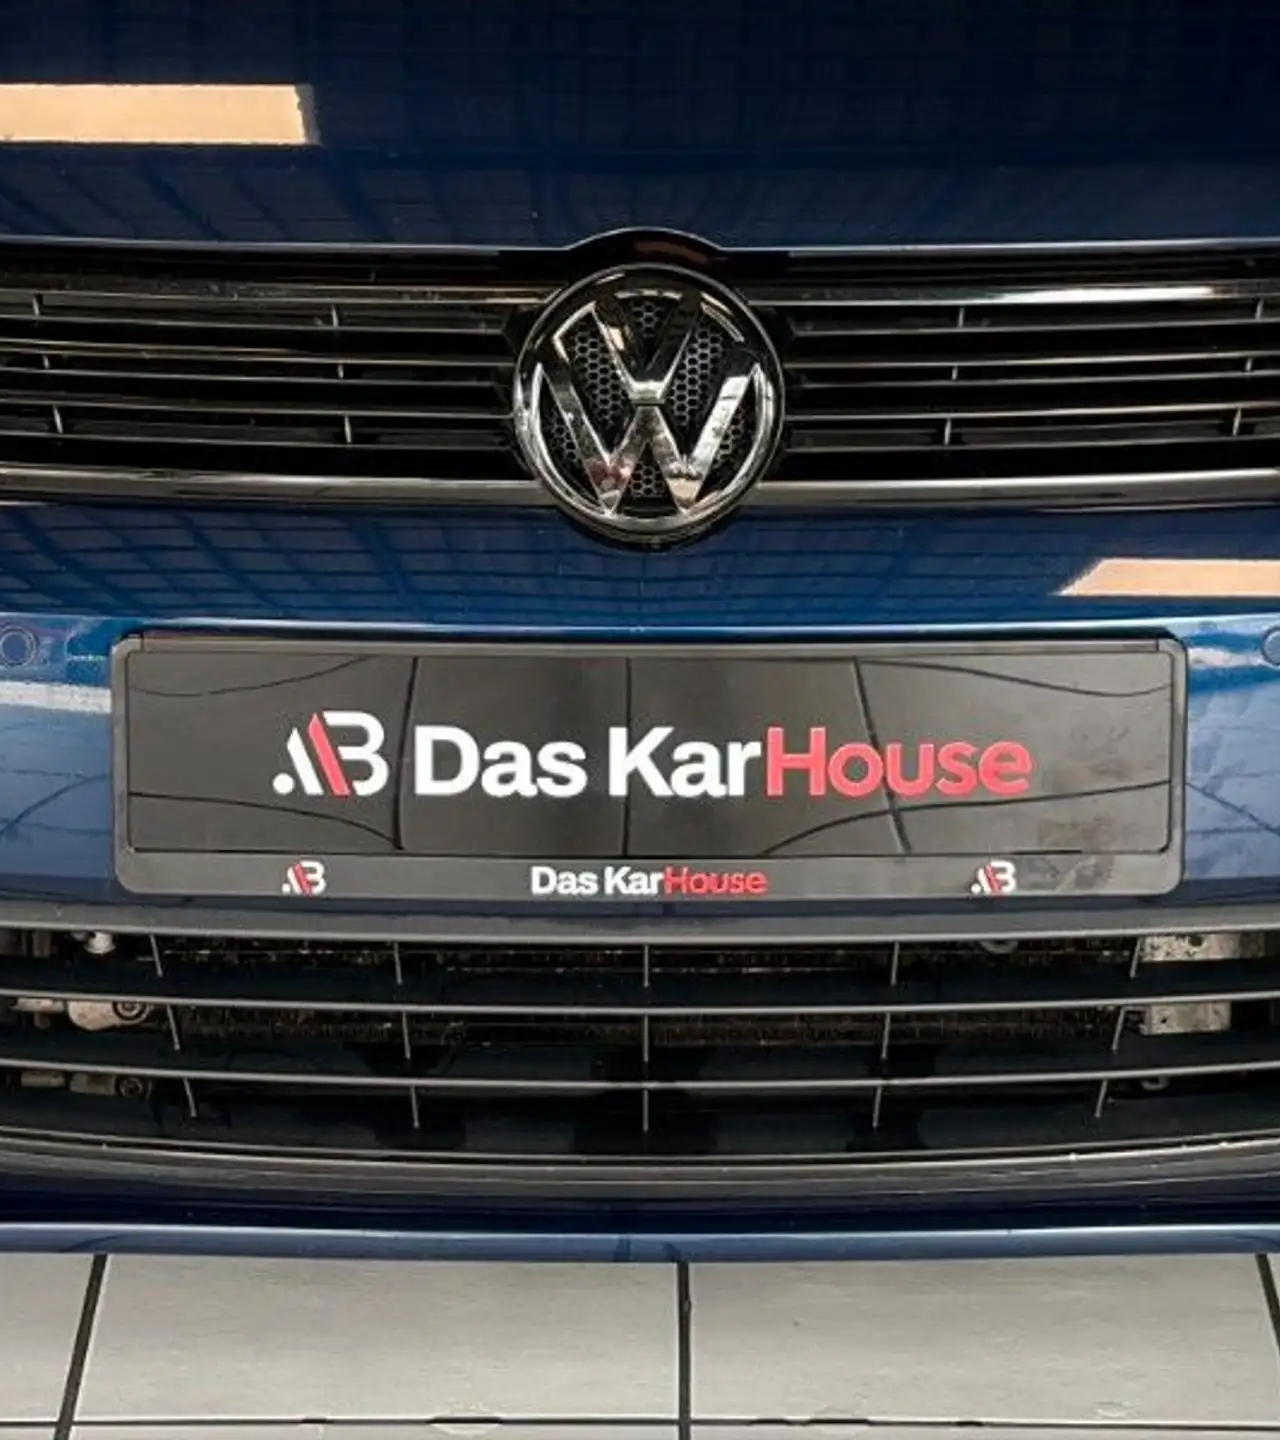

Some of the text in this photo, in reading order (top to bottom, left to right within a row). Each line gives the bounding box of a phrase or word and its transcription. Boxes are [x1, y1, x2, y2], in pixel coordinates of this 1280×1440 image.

[415, 725, 587, 797] Das
[609, 726, 1032, 797] KarHouse
[531, 867, 767, 895] Das KarHouse
